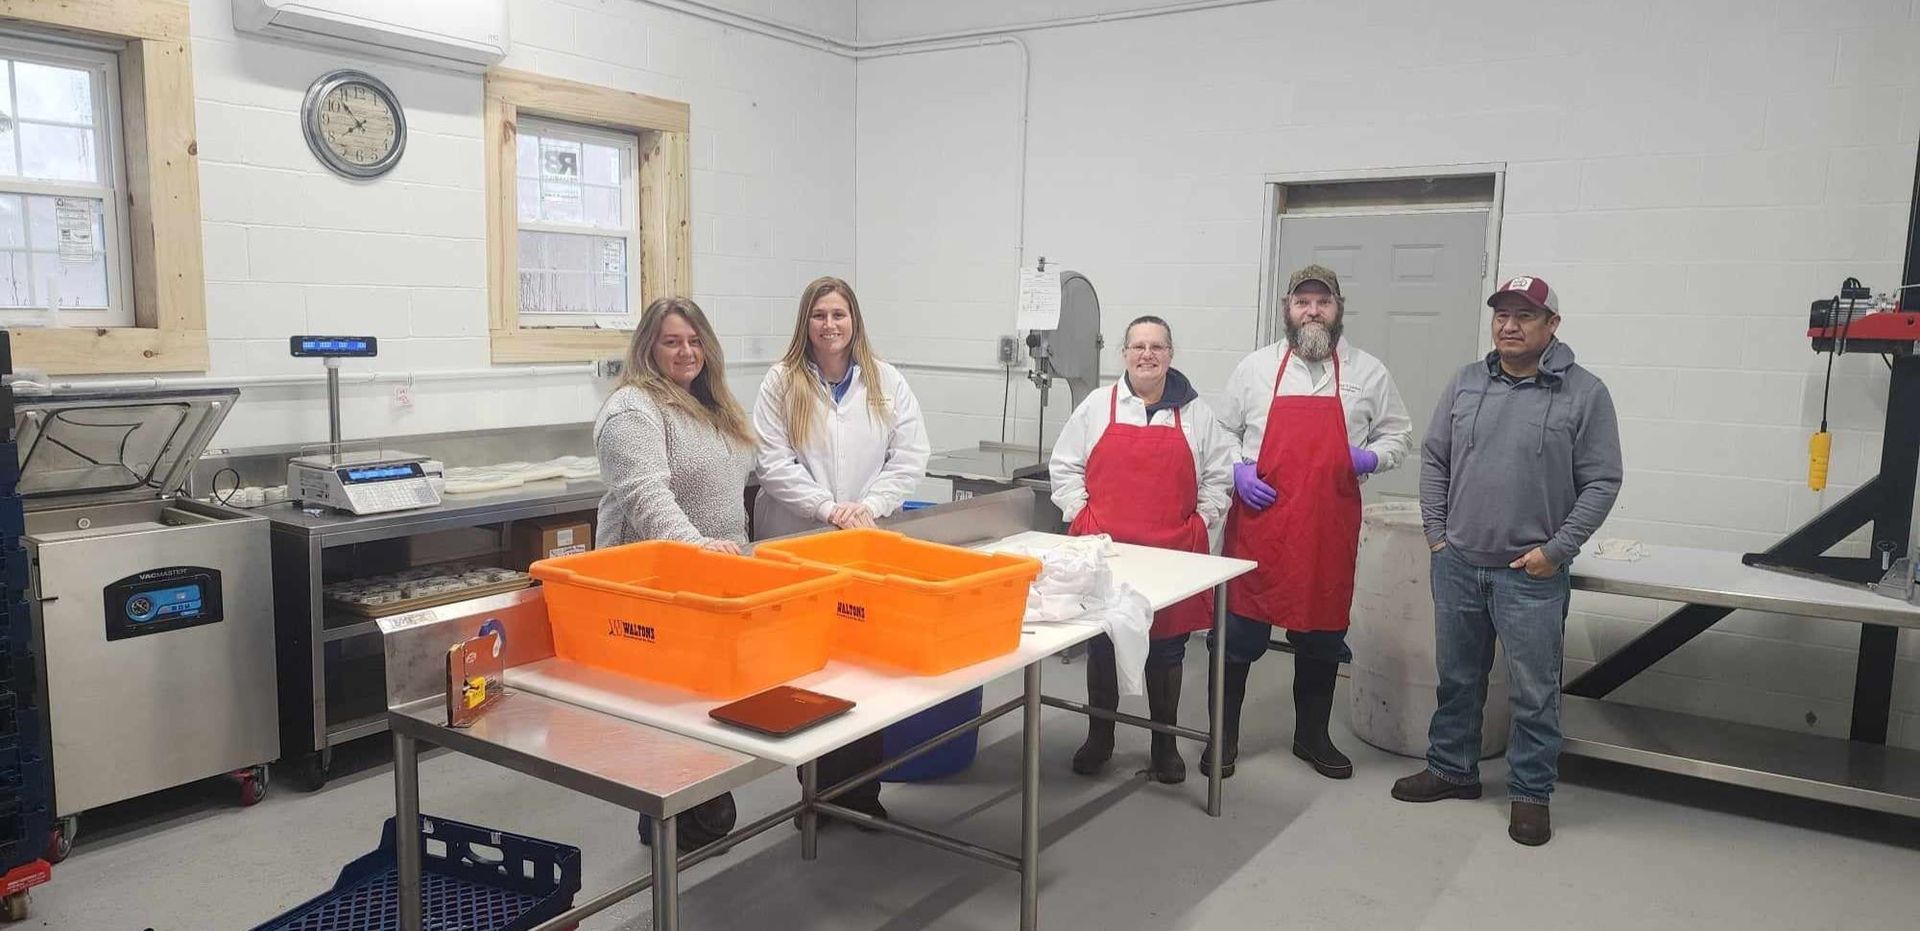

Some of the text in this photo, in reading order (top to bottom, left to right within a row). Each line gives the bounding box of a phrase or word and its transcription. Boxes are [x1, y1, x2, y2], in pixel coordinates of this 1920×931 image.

[354, 86, 366, 101] 12
[328, 99, 340, 112] 10
[322, 113, 330, 125] 9
[327, 131, 336, 143] 8
[356, 150, 364, 162] 6
[139, 568, 187, 580] VACMASTER
[623, 621, 655, 640] WALTONS
